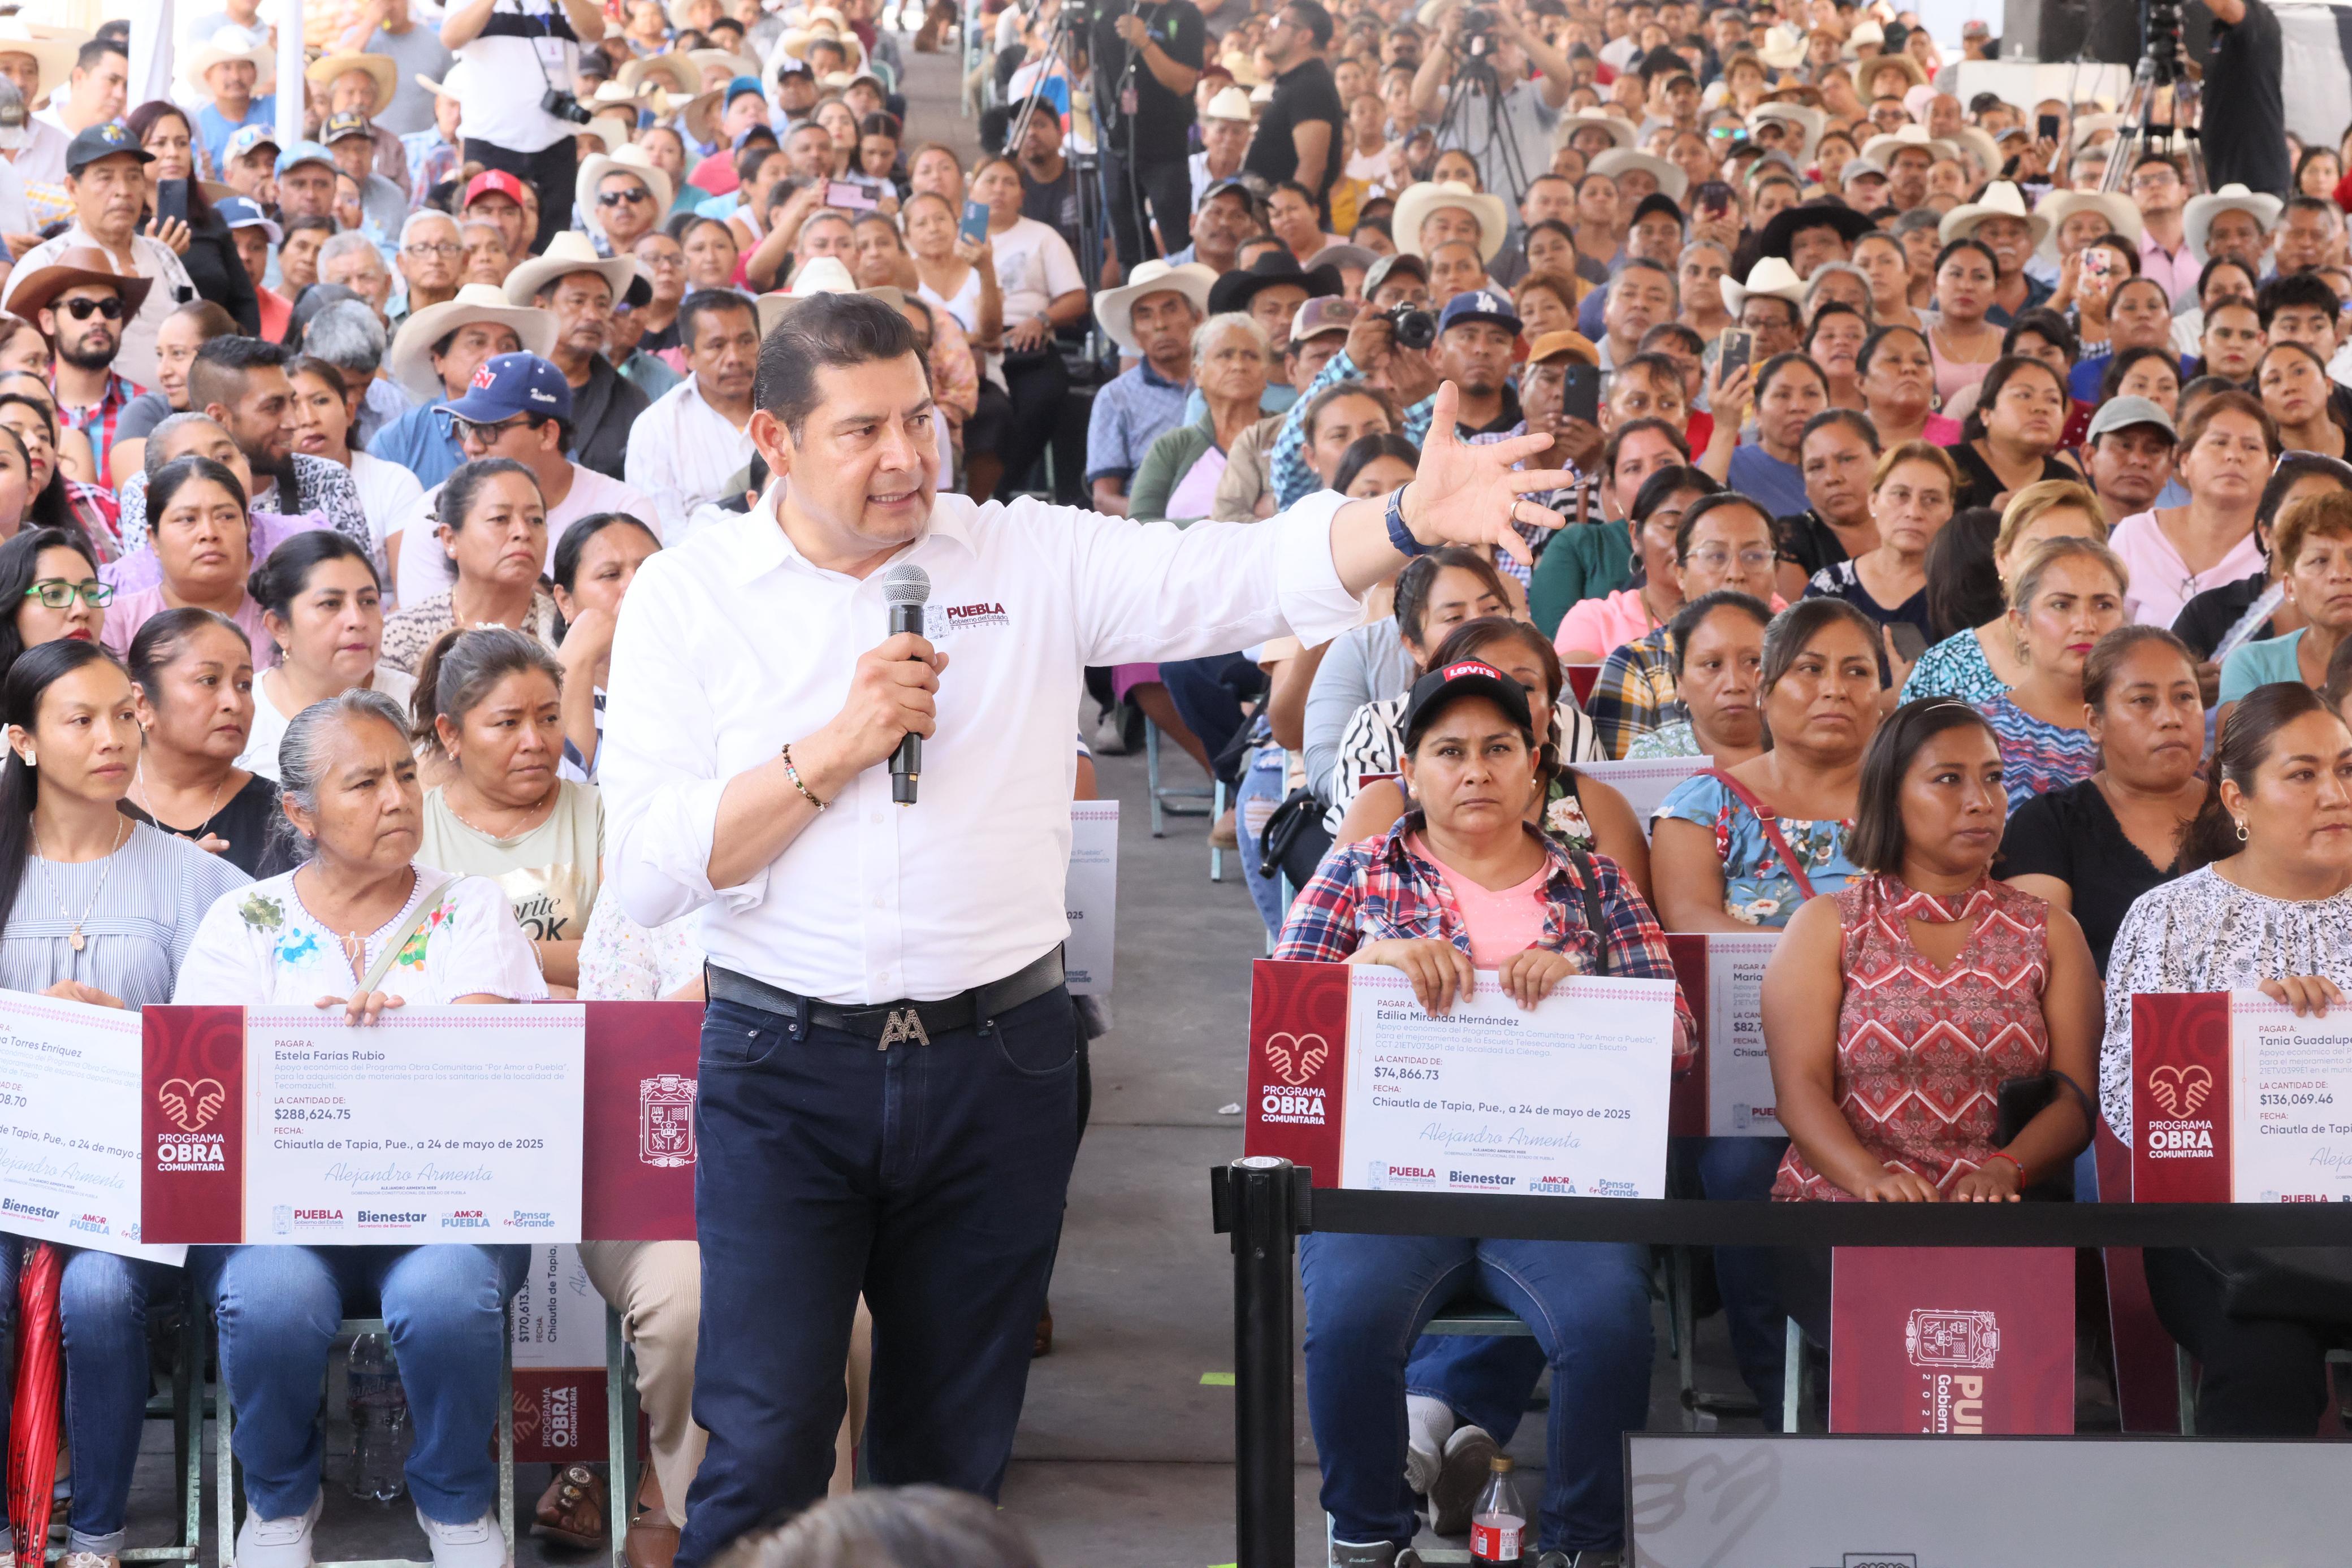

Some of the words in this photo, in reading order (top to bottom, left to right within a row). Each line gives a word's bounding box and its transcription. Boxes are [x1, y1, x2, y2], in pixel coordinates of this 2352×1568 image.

[946, 603, 1005, 619] PUEBLA
[1377, 999, 1406, 1008] PAGAR
[1377, 1010, 1407, 1021] Edilia
[1410, 1011, 1456, 1023] Miranda
[1459, 1013, 1519, 1026] Hernández
[11, 1037, 39, 1050] Torres
[1406, 1034, 1460, 1043] mejoramiento
[1516, 1039, 1576, 1049] Telesecundaria
[2259, 1036, 2290, 1045] Tania
[275, 1050, 310, 1060] Estela
[353, 1051, 384, 1060] Rubio
[1467, 1046, 1503, 1054] localidad
[1386, 1055, 1428, 1064] CANTIDAD
[274, 1064, 301, 1072] Apoyo
[366, 1064, 407, 1073] Programa
[1374, 1066, 1439, 1080] $74,866.73
[306, 1073, 353, 1082] adquisición
[1263, 1085, 1326, 1098] PROGRAMA
[1373, 1085, 1401, 1094] FECHA:
[2271, 1081, 2314, 1090] CANTIDAD
[1261, 1095, 1325, 1116] OBRA
[2260, 1093, 2333, 1106] $136,069.46
[1373, 1097, 1420, 1108] Chiautla
[1423, 1099, 1437, 1108] de
[1441, 1101, 1475, 1112] Tapia,
[1479, 1102, 1505, 1114] Pue.,
[1519, 1104, 1532, 1114] 24
[1536, 1106, 1549, 1115] de
[1553, 1108, 1583, 1118] mayo
[1587, 1108, 1601, 1117] de
[1604, 1109, 1631, 1119] 2025
[275, 1108, 351, 1121] $288,624.75
[1261, 1114, 1325, 1125] COMUNITARIA
[2148, 1121, 2213, 1130] PROGRAMA
[2260, 1124, 2308, 1134] Chiautla
[2311, 1124, 2325, 1133] de
[12, 1127, 40, 1142] Tapia,
[43, 1133, 66, 1146] Pue.,
[77, 1140, 89, 1149] 24
[92, 1143, 104, 1152] de
[107, 1147, 132, 1158] mayo
[158, 1134, 224, 1143] PROGRAMA
[1507, 1127, 1582, 1149] Armenta
[2148, 1131, 2213, 1149] OBRA
[274, 1140, 323, 1149] Chiautla
[327, 1140, 341, 1149] de
[345, 1140, 381, 1151] Tapia,
[386, 1140, 413, 1150] Pue.,
[427, 1140, 441, 1149] 24
[445, 1140, 459, 1149] de
[463, 1142, 494, 1151] mayo
[498, 1140, 512, 1149] de
[516, 1139, 543, 1148] 2025
[158, 1144, 224, 1162] OBRA
[2149, 1150, 2213, 1158] COMUNITARIA
[158, 1163, 224, 1171] COMUNITARIA
[417, 1162, 493, 1181] Armenta
[1389, 1166, 1436, 1178] PUEBLA
[1449, 1171, 1516, 1185] Bienestar
[1542, 1176, 1570, 1184] AMOR
[1529, 1183, 1577, 1194] PUEBLA
[1599, 1179, 1635, 1189] Pensar
[1601, 1188, 1639, 1197] Grande
[2, 1198, 60, 1219] Bienestar
[513, 1210, 551, 1219] Pensar
[81, 1214, 107, 1225] AMOR
[295, 1210, 343, 1219] PUEBLA
[358, 1210, 427, 1223] Bienestar
[69, 1219, 110, 1235] PUEBLA
[442, 1218, 491, 1228] PUEBLA
[548, 1281, 557, 1294] de
[548, 1297, 557, 1342] Chiautla
[543, 1387, 551, 1447] PROGRAMA
[552, 1387, 569, 1448] OBRA
